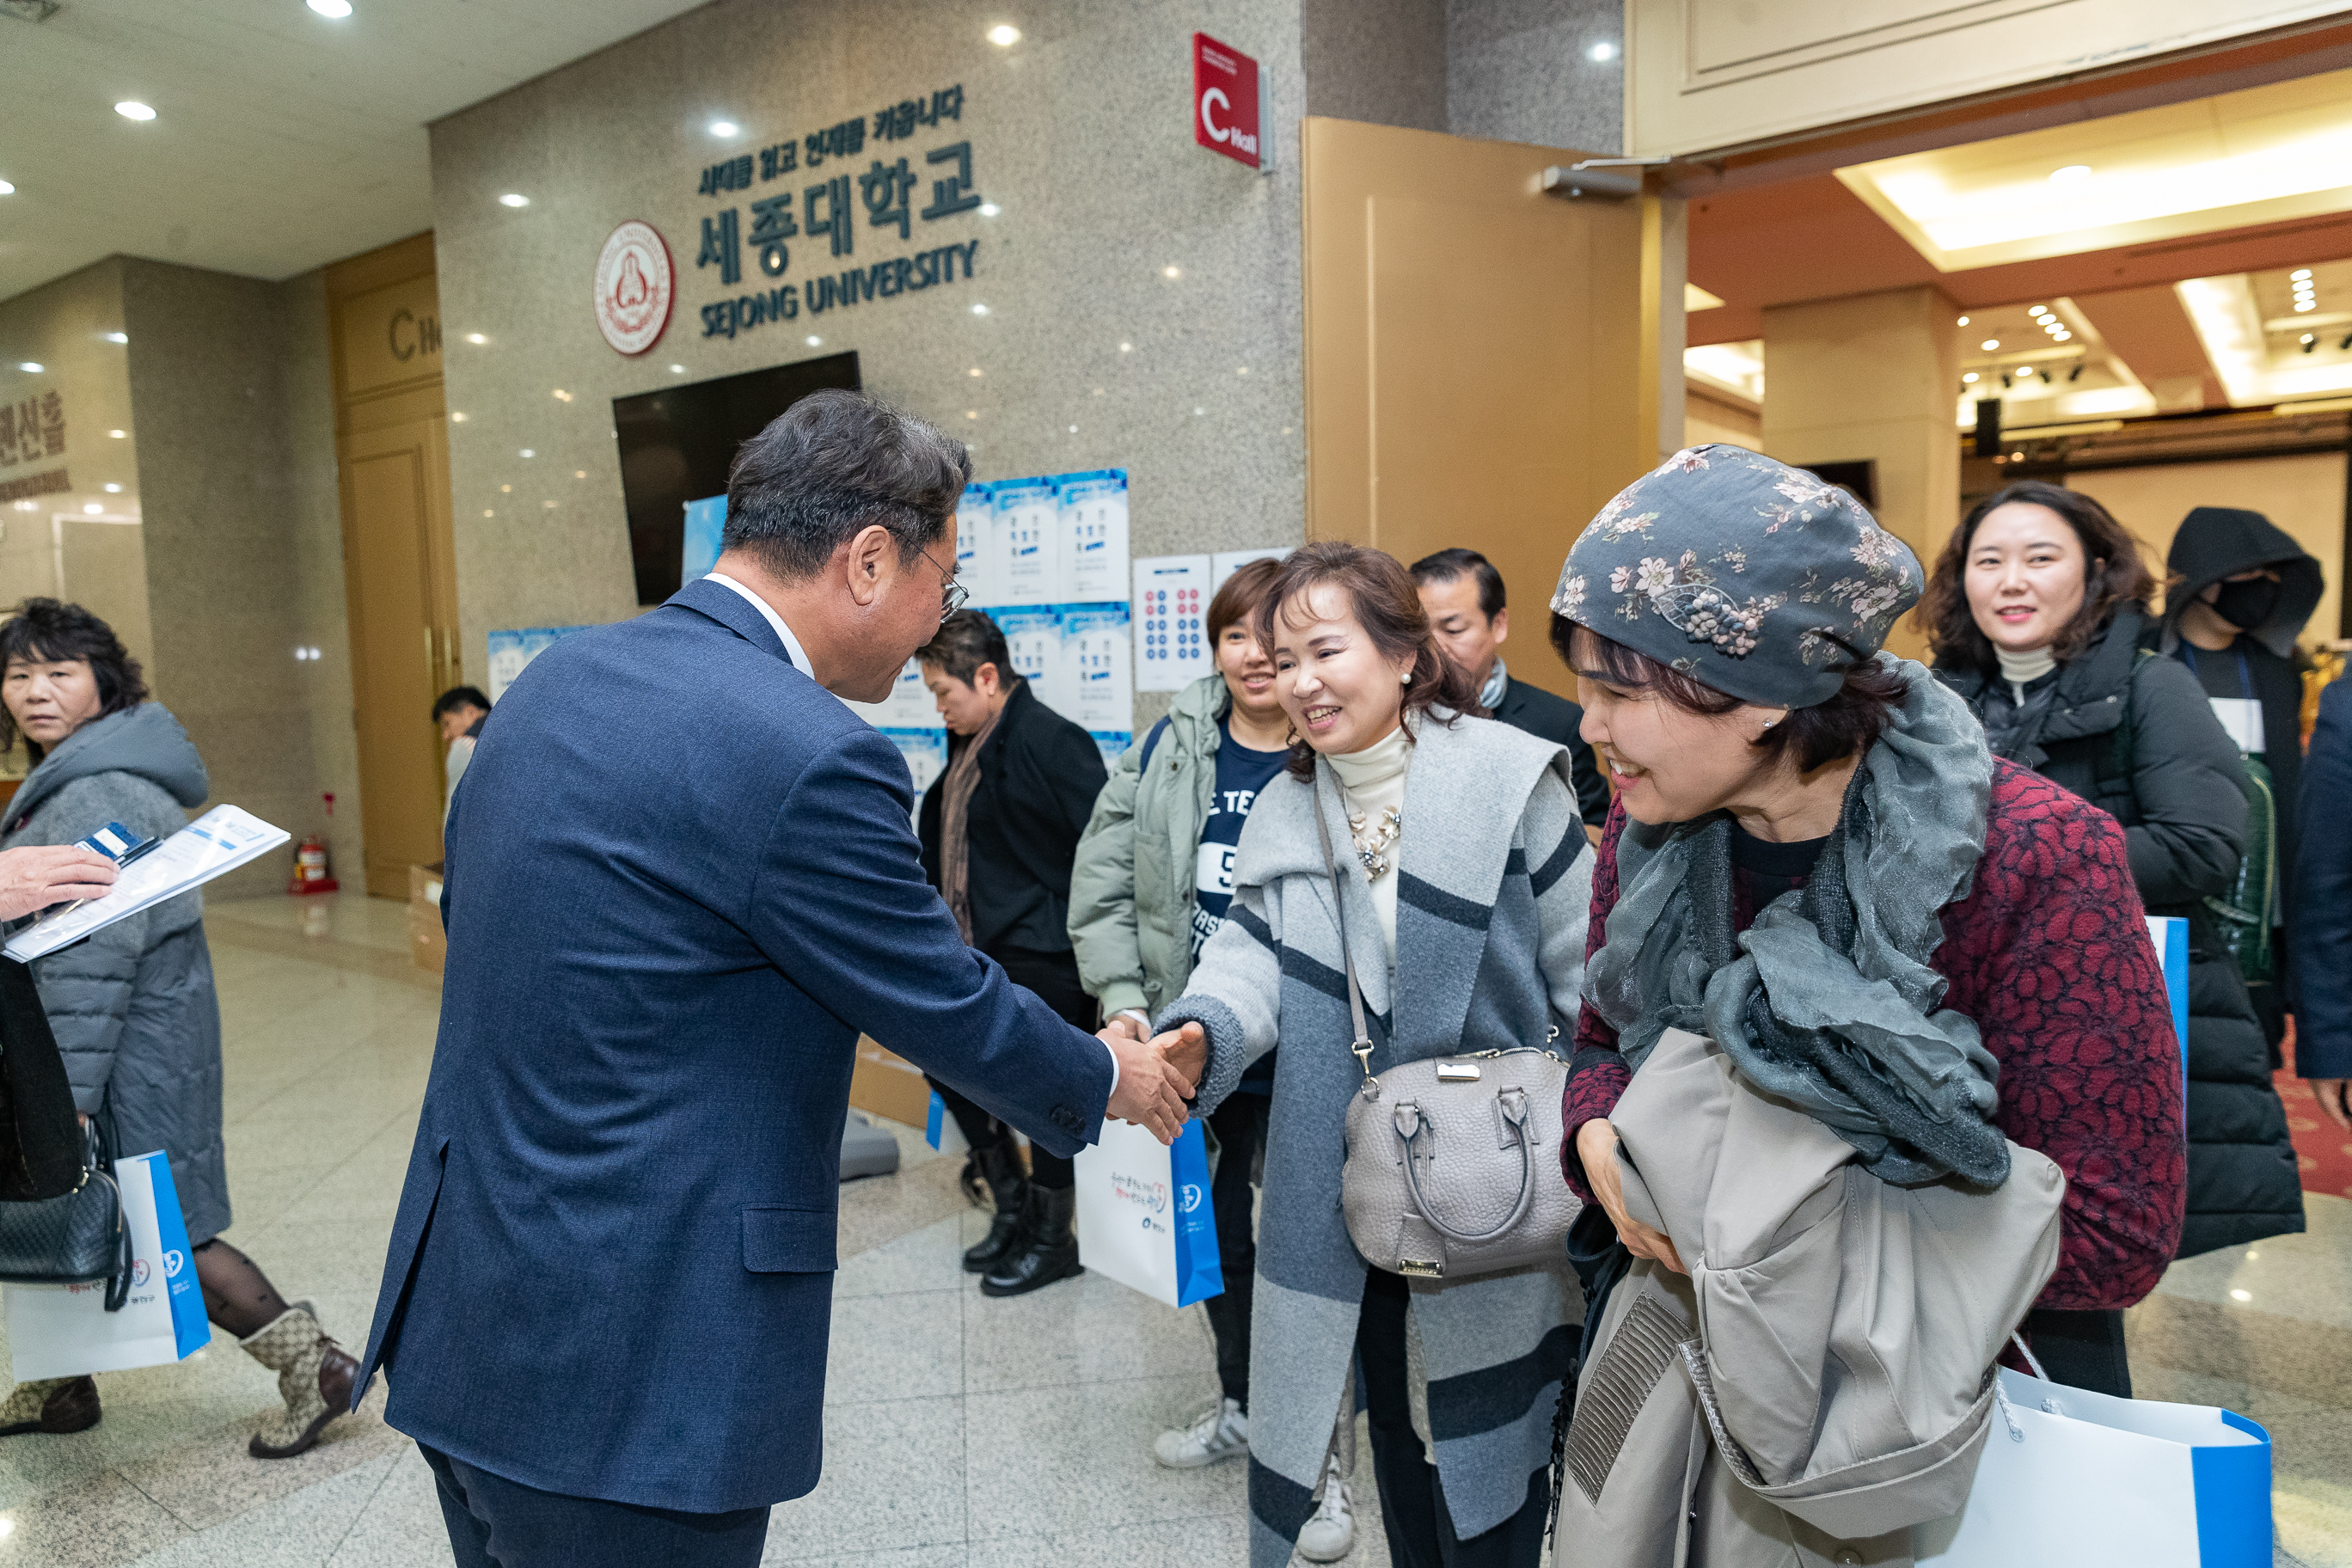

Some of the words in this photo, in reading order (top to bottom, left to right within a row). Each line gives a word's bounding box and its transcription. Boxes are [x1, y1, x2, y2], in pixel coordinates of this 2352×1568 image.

[1201, 87, 1231, 143] C
[695, 141, 982, 285] 세종대학교
[701, 285, 799, 339] SEJONG
[805, 239, 979, 315] UNIVERSITY
[389, 309, 416, 362] C
